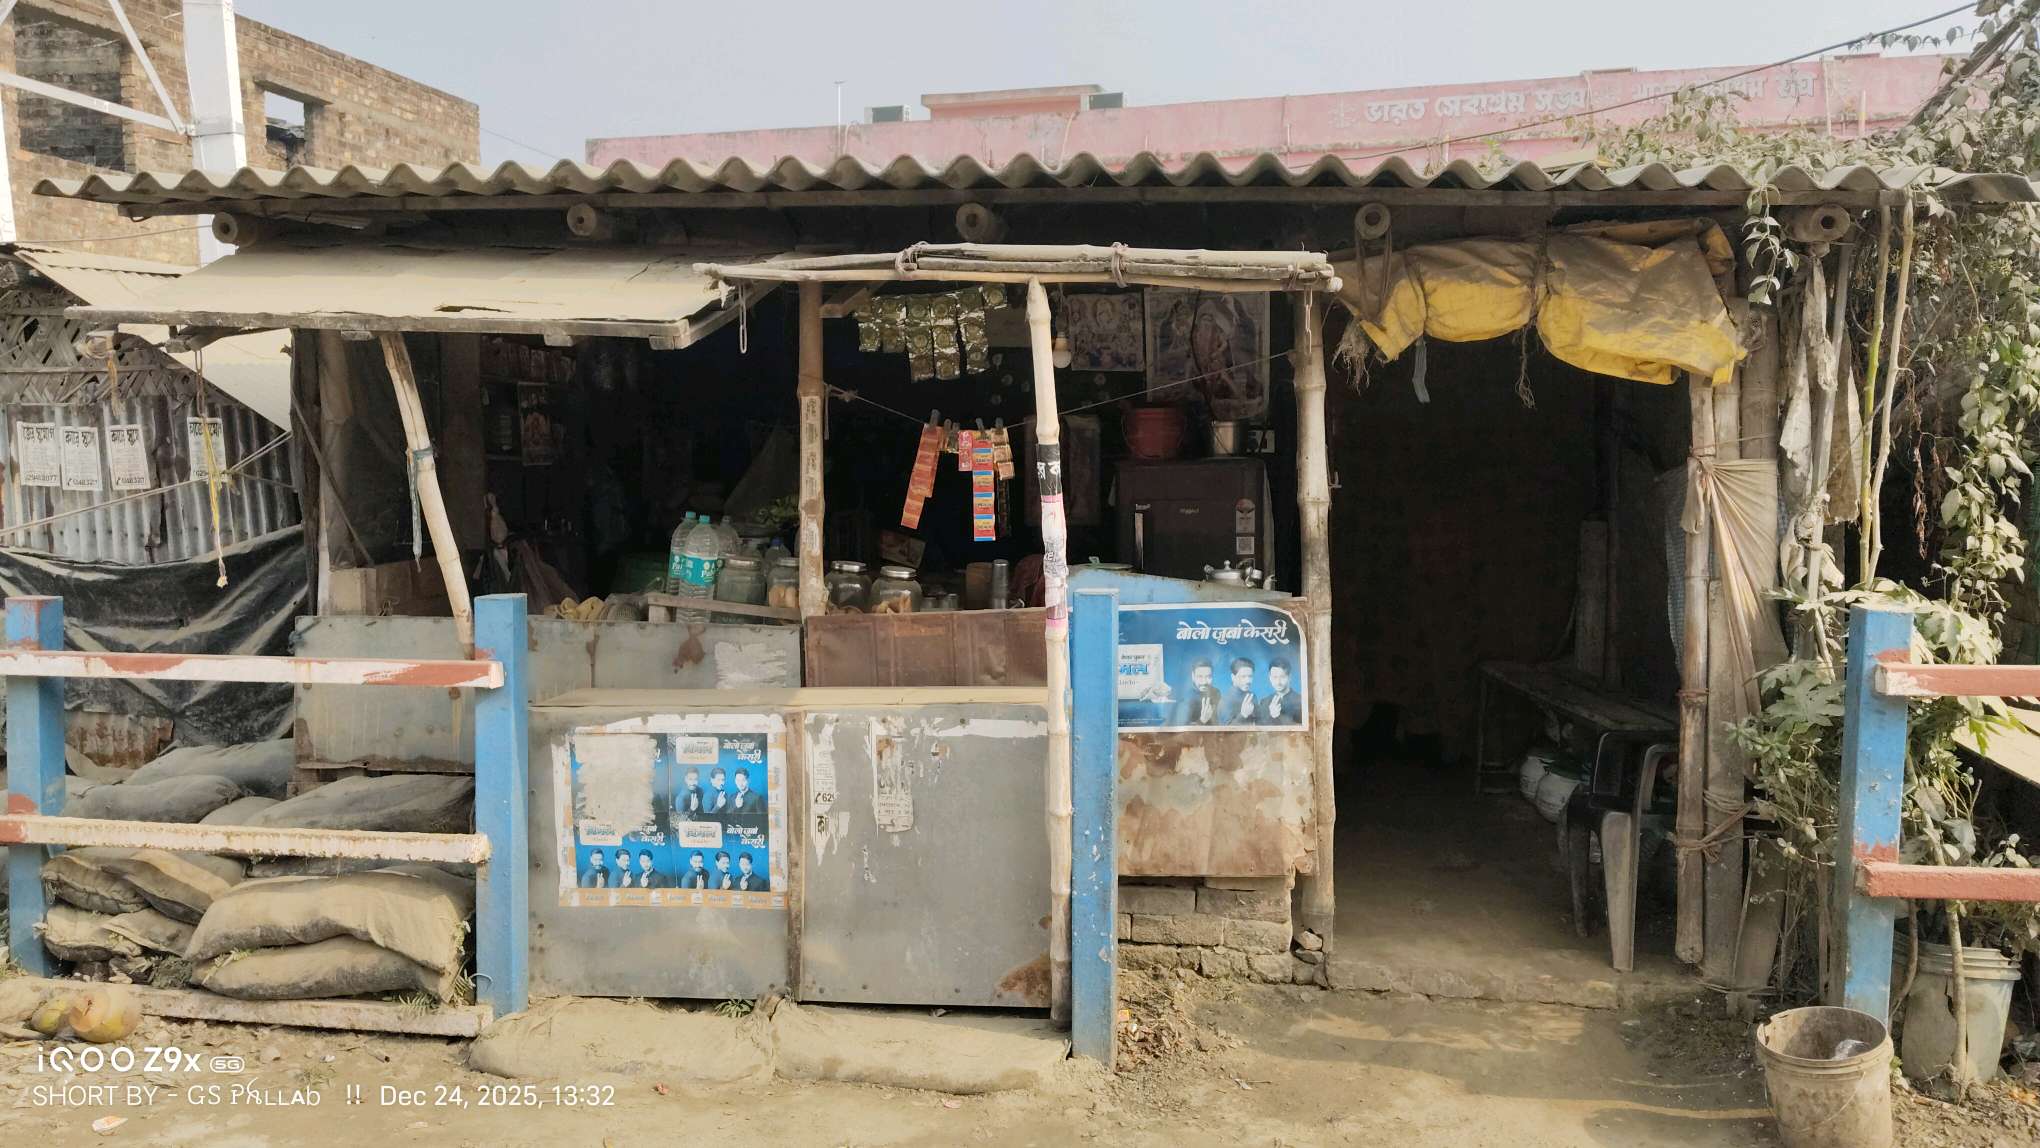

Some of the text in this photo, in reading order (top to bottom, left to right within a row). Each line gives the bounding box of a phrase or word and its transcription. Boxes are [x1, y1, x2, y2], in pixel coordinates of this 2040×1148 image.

[1365, 98, 1430, 125] ভারত
[1176, 619, 1290, 645] बोलो जुबां केसरी
